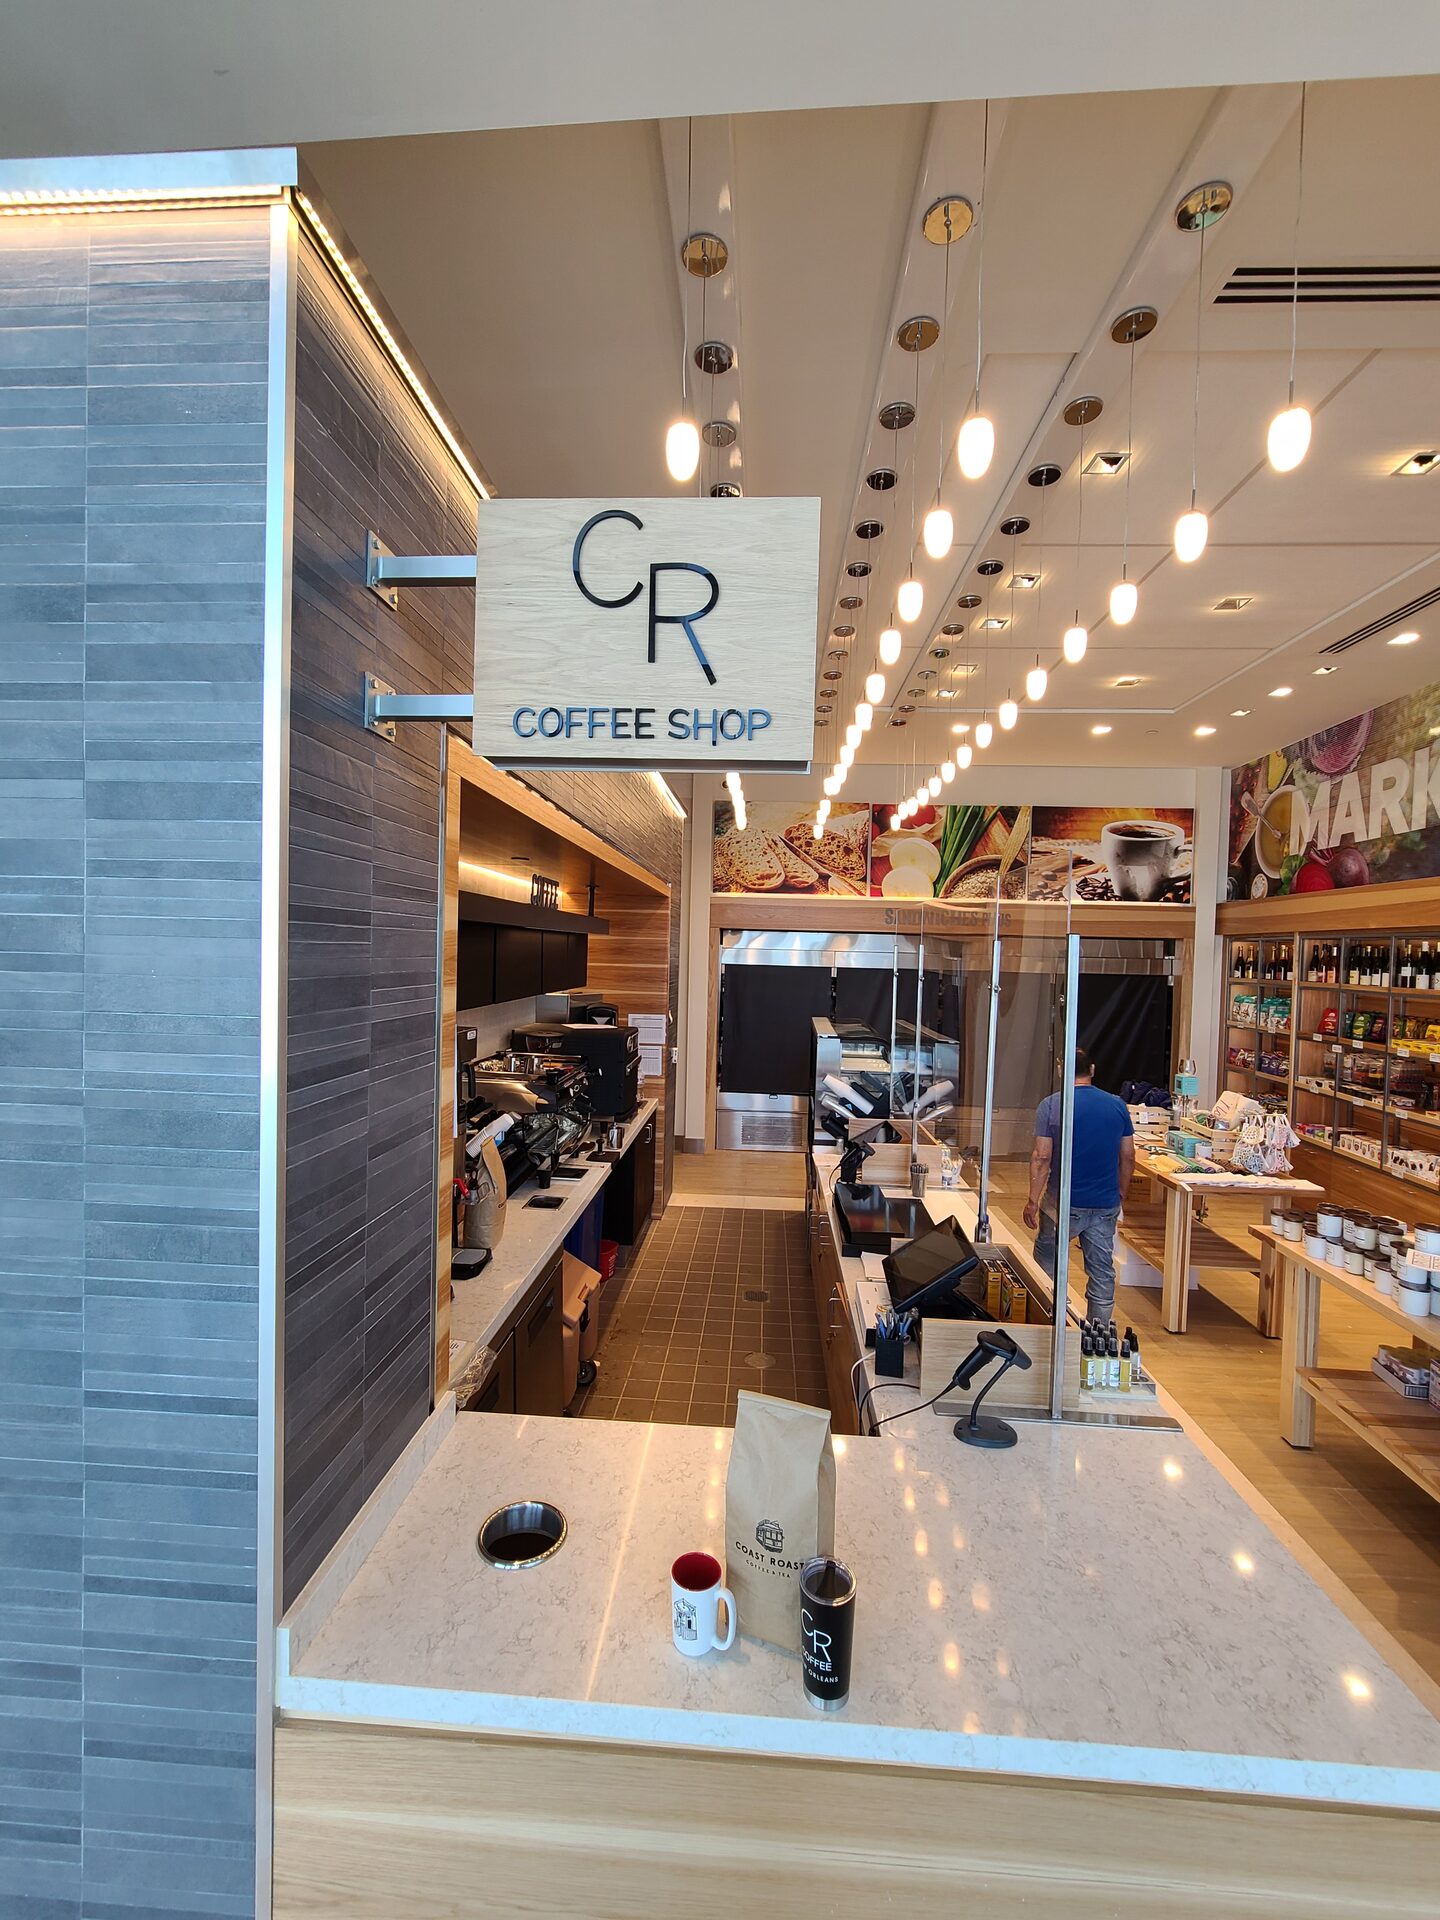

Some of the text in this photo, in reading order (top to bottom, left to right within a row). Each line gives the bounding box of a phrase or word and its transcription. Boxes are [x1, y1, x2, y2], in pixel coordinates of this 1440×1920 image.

[512, 707, 772, 746] COFFEE SHOP
[530, 873, 560, 909] COFFEE
[735, 1541, 805, 1570] COAST ROAST
[745, 1559, 770, 1574] COFFEE
[778, 1569, 791, 1579] TEA
[808, 1668, 839, 1683] ORLEANS
